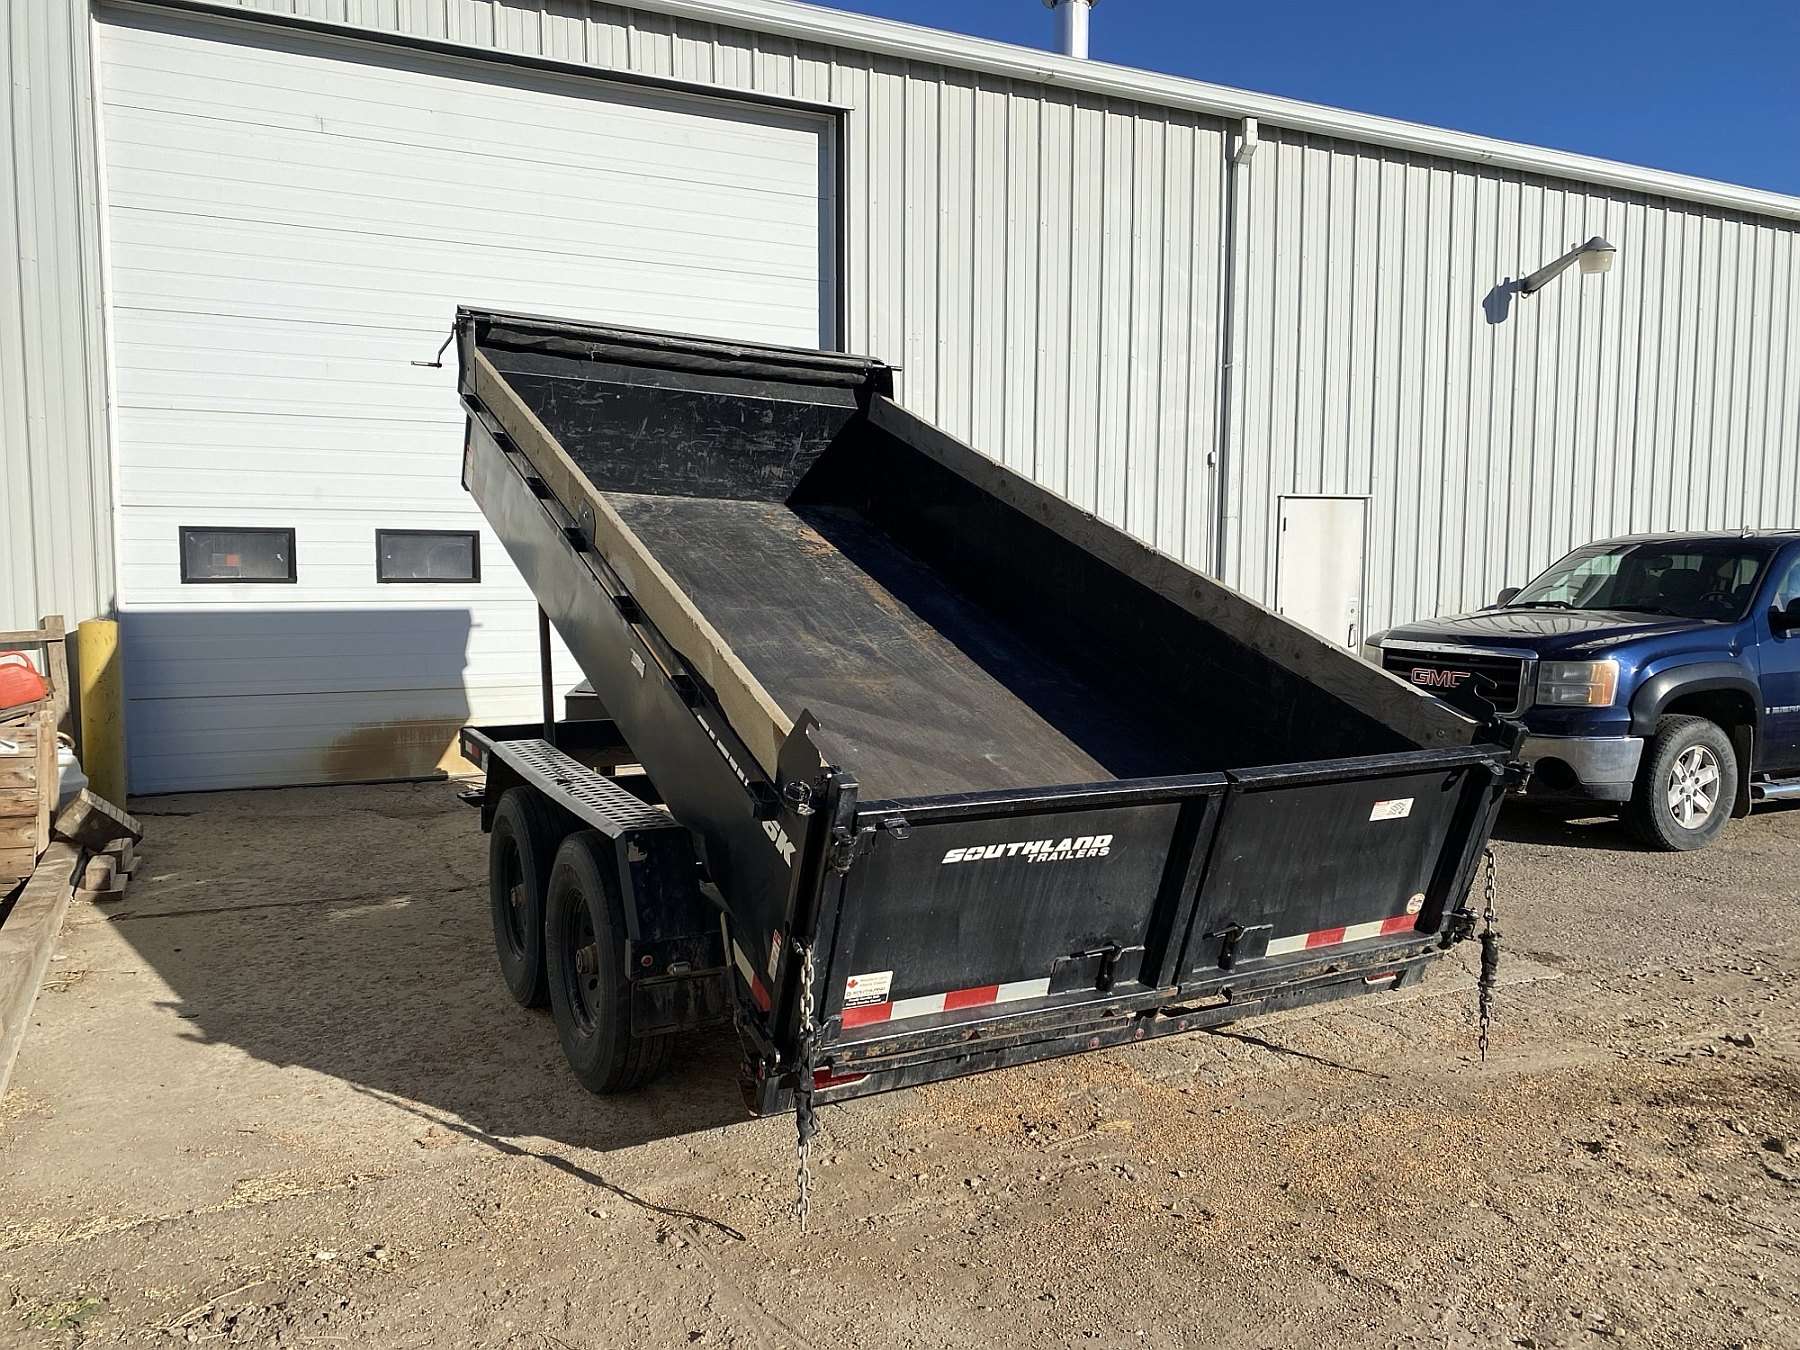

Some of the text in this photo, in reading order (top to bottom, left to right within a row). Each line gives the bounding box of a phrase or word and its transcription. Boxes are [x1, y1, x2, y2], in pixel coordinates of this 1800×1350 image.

[1411, 667, 1471, 688] GMC
[941, 834, 1114, 865] SOUTHLAND
[1027, 846, 1111, 864] TRAILERS
